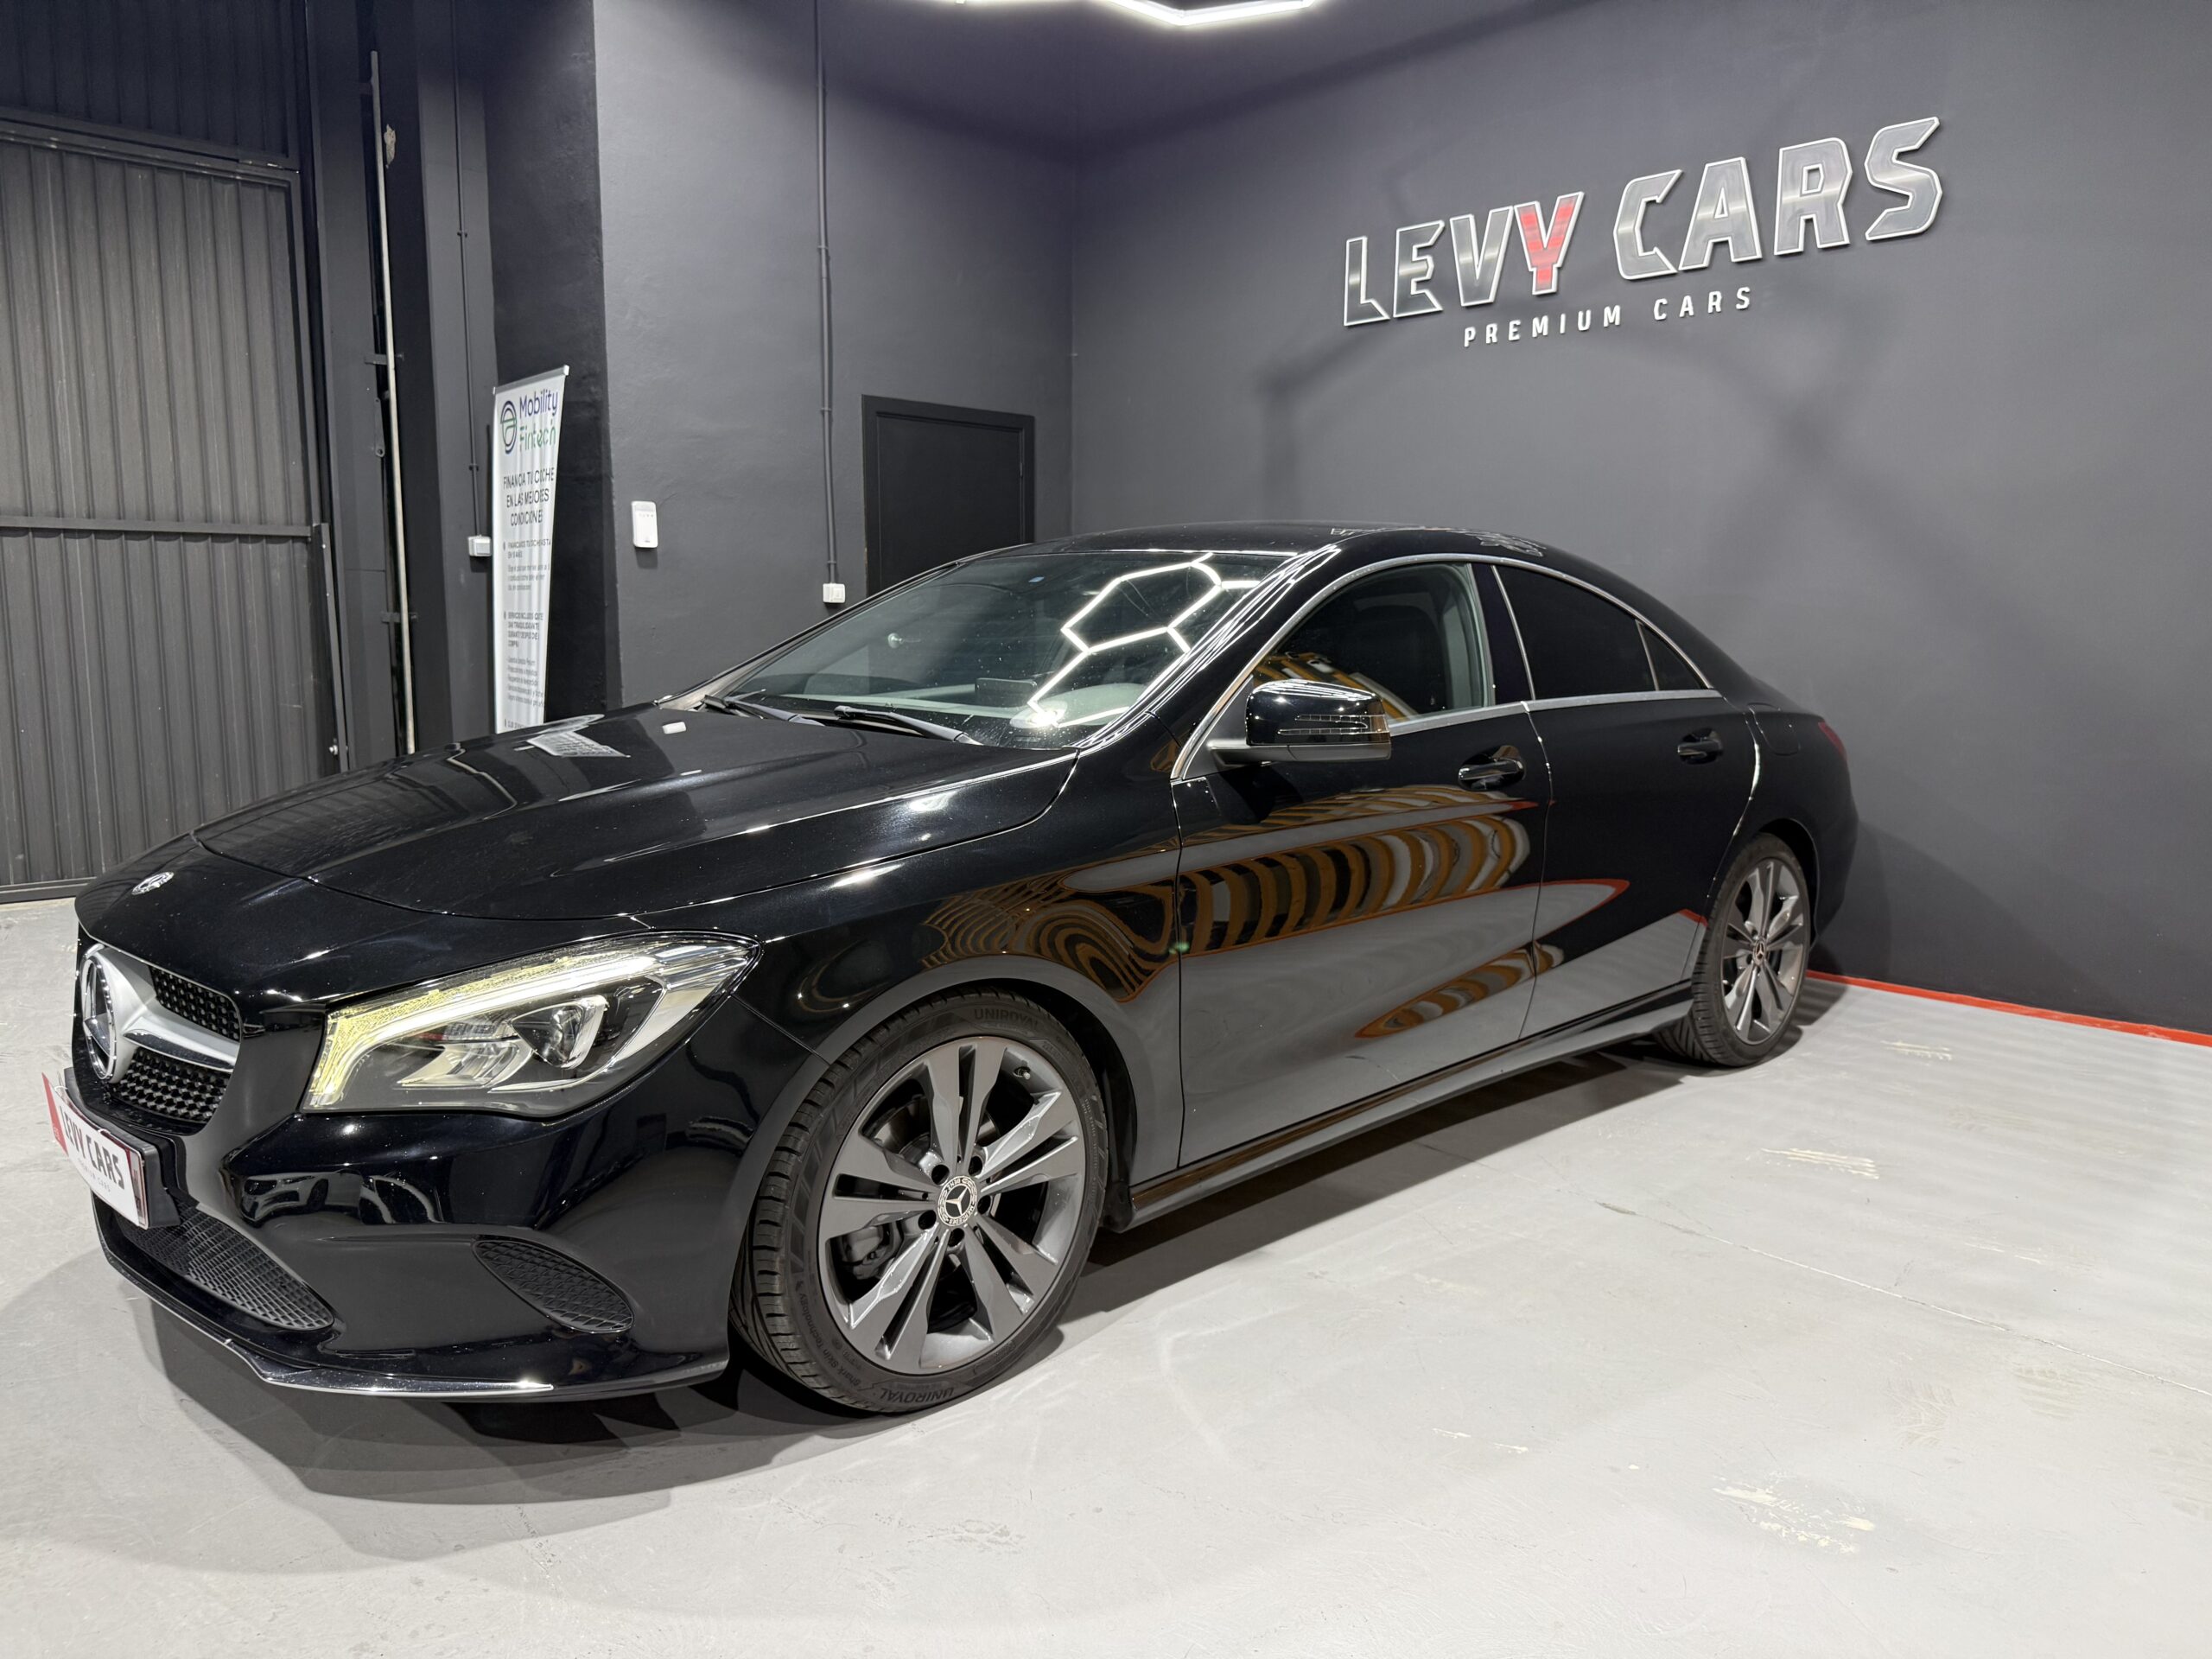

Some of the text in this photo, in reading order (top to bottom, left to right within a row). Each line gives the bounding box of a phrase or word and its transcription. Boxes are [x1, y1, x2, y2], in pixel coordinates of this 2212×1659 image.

[1344, 116, 1943, 327] LEVY CARS
[1464, 287, 1751, 347] PREMIUM CARS
[519, 389, 558, 419] Mobility
[59, 1105, 86, 1159] LEVY
[86, 1134, 125, 1191] CARS
[798, 1293, 823, 1349] Technology
[821, 1348, 839, 1368] Skin
[879, 1387, 955, 1403] UNIROYAL
